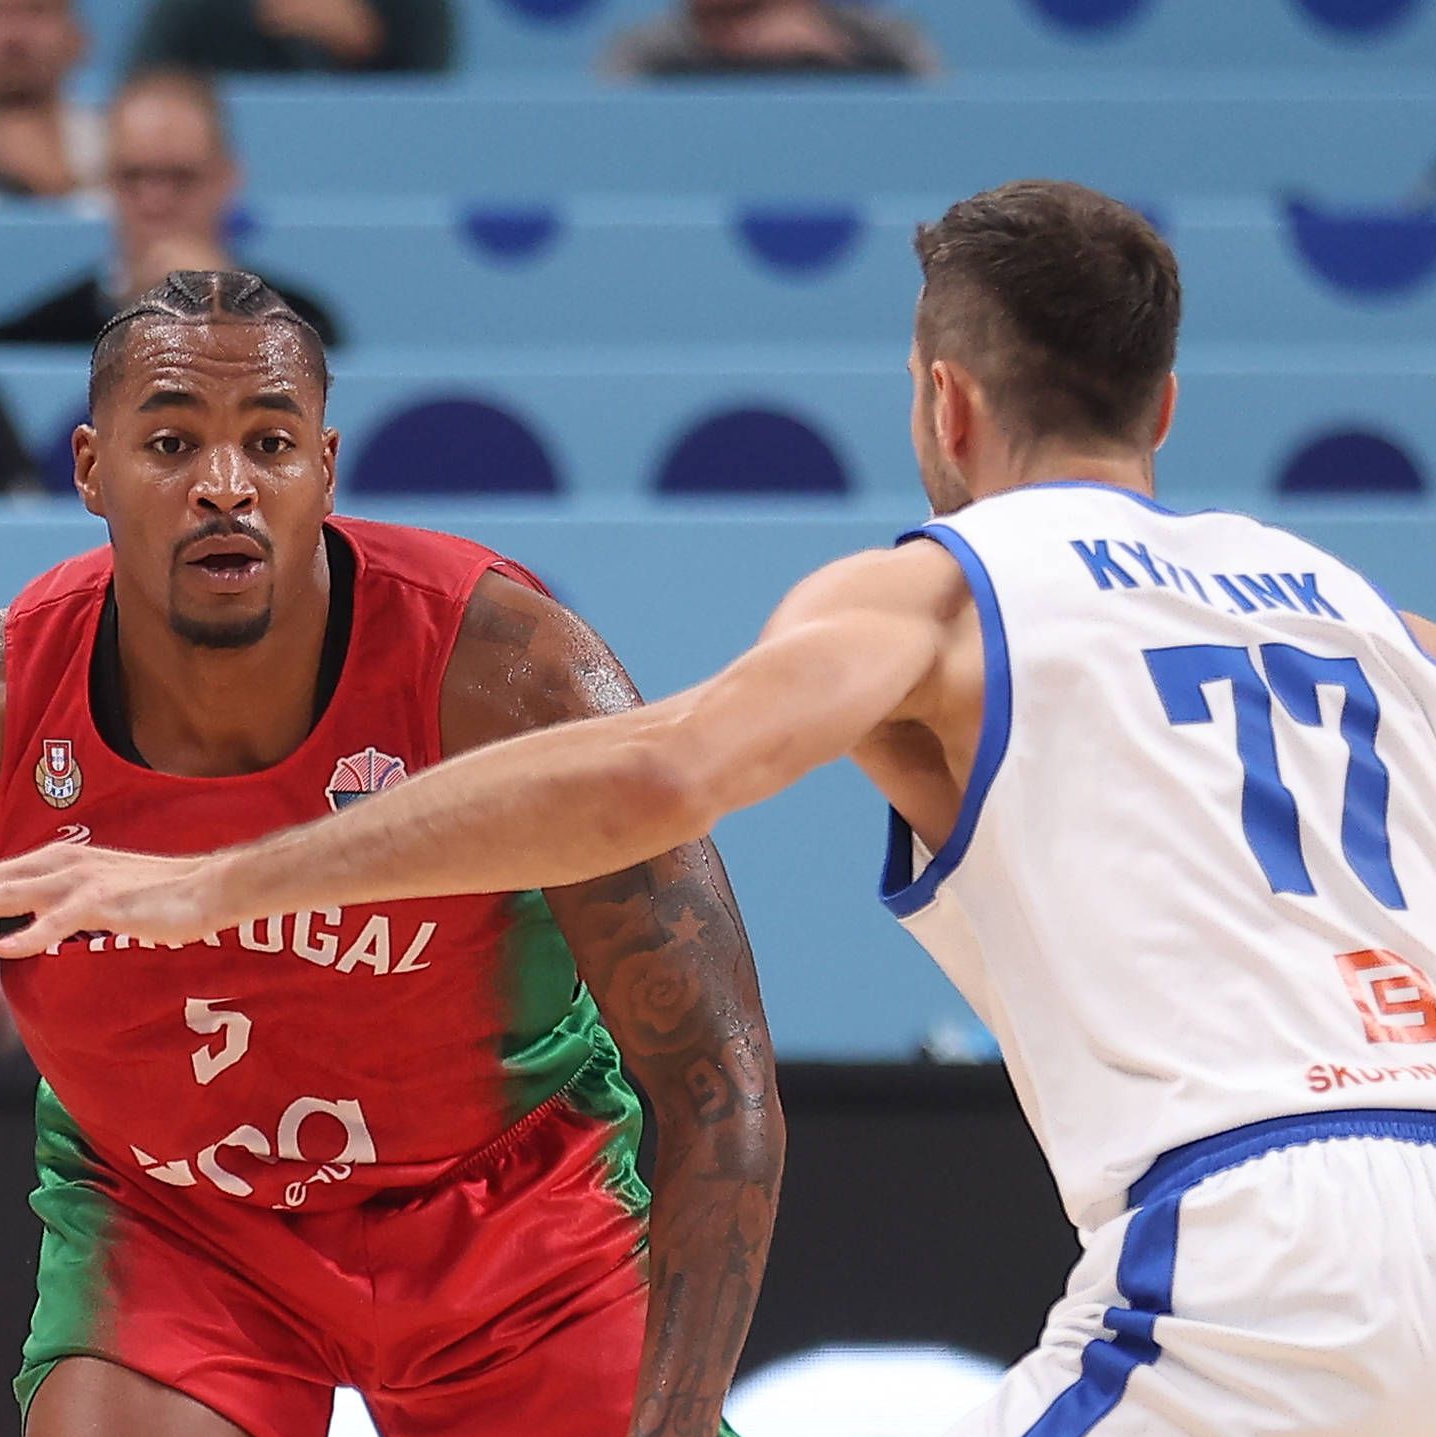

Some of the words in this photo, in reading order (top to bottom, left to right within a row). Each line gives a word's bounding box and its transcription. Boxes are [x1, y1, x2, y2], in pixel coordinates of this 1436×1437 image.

[1142, 641, 1409, 911] 77
[44, 906, 438, 977] UGAL
[184, 996, 253, 1086] 5
